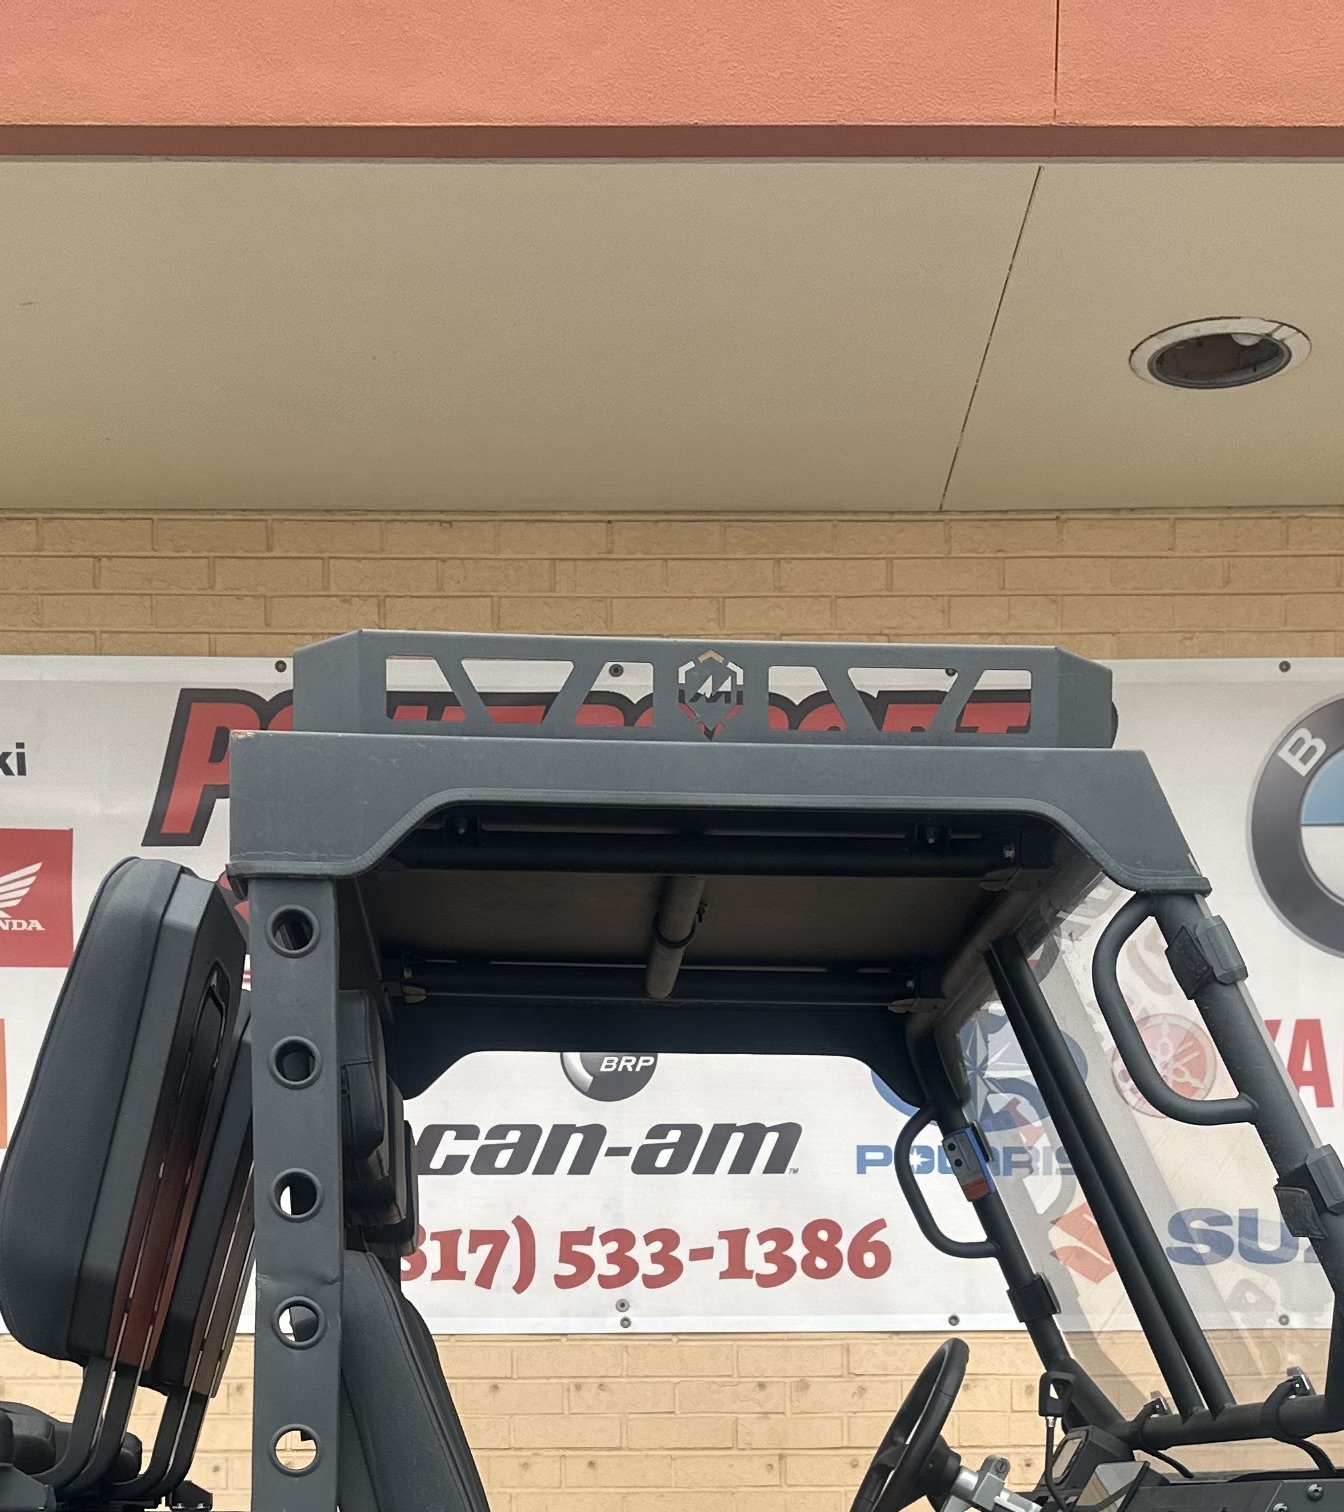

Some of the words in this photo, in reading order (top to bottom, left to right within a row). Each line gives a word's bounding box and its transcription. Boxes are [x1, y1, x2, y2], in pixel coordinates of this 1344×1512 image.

[599, 1055, 655, 1072] BRP
[416, 1121, 803, 1176] can-am
[553, 1218, 893, 1289] 533-1386
